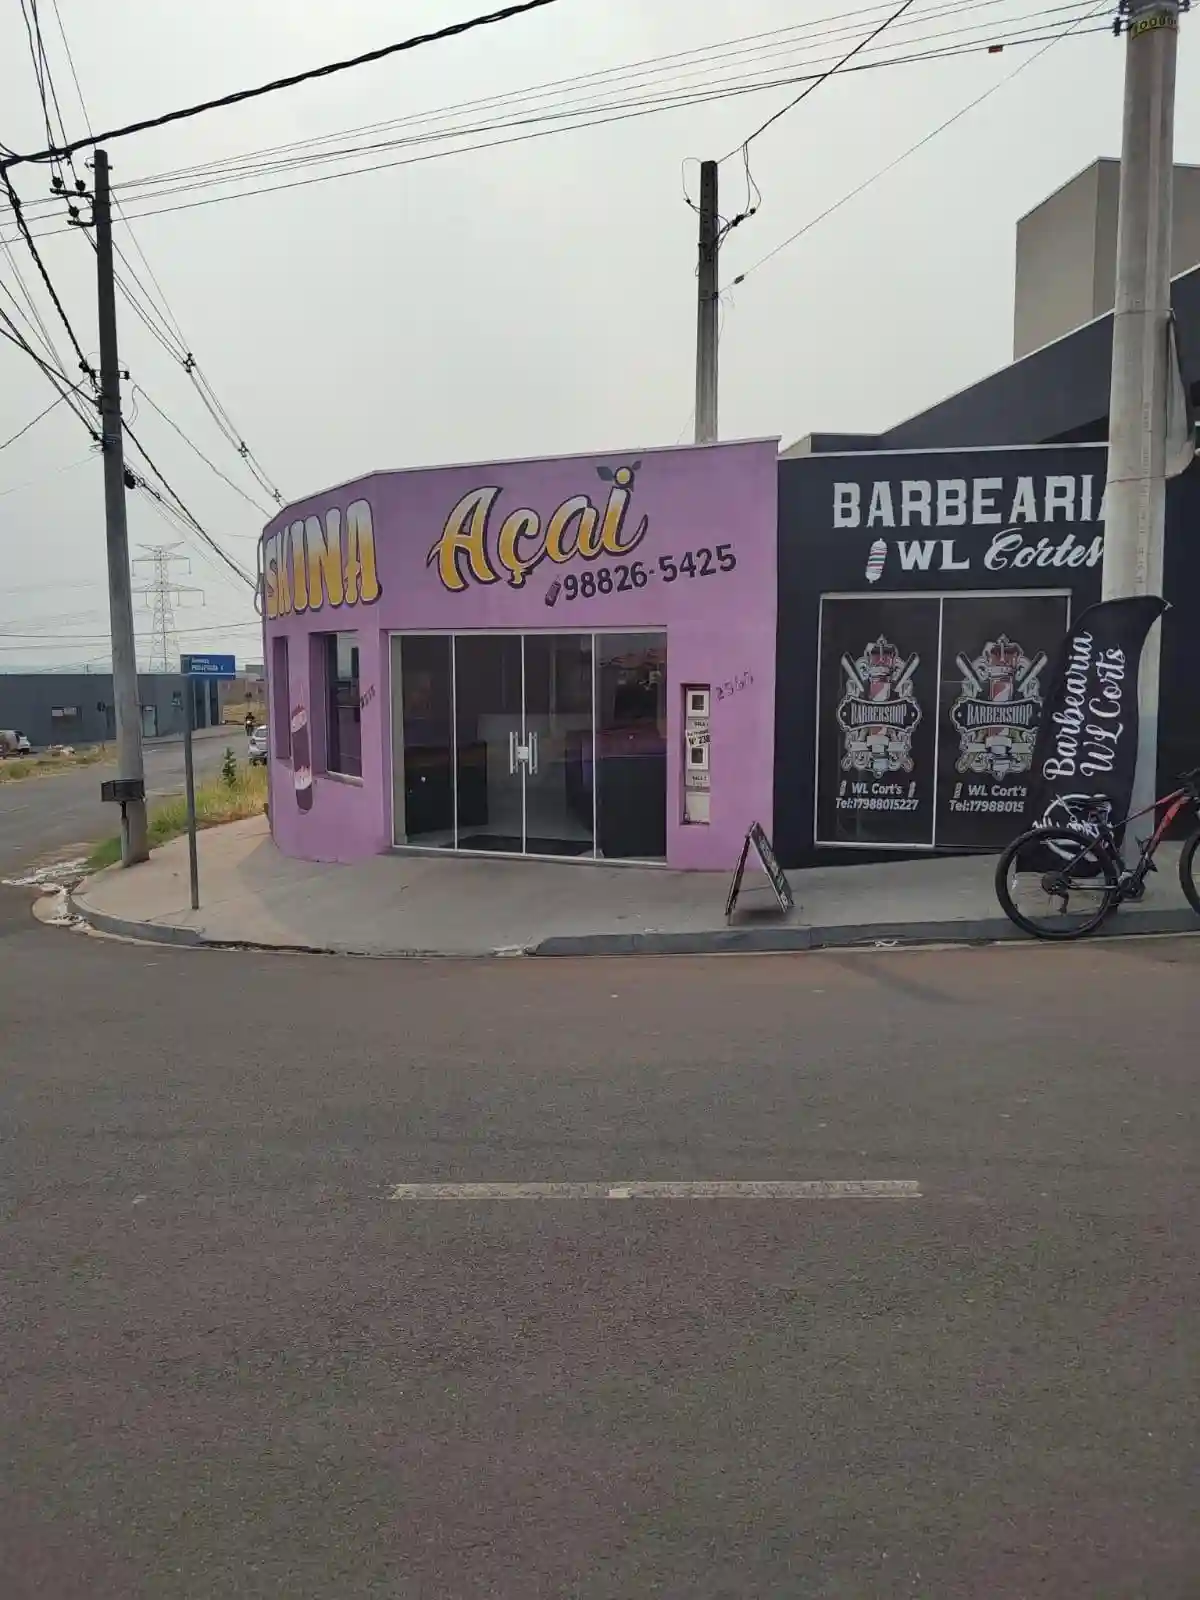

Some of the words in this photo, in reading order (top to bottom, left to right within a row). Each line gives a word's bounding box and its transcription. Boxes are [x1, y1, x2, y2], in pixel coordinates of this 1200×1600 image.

[832, 474, 1105, 528] BARBEARI
[897, 539, 970, 570] WL
[563, 543, 737, 602] 98826-5425
[1088, 644, 1126, 719] Corts
[850, 703, 907, 725] BARBERSHOP
[966, 702, 1034, 726] BARBERSHOP
[1042, 630, 1093, 781] Barbearia
[1079, 723, 1124, 778] WL
[851, 782, 869, 794] WL
[871, 782, 903, 796] Cort's
[967, 784, 989, 797] WL
[991, 785, 1027, 797] Cort's
[949, 799, 1025, 813] Tel:17988015
